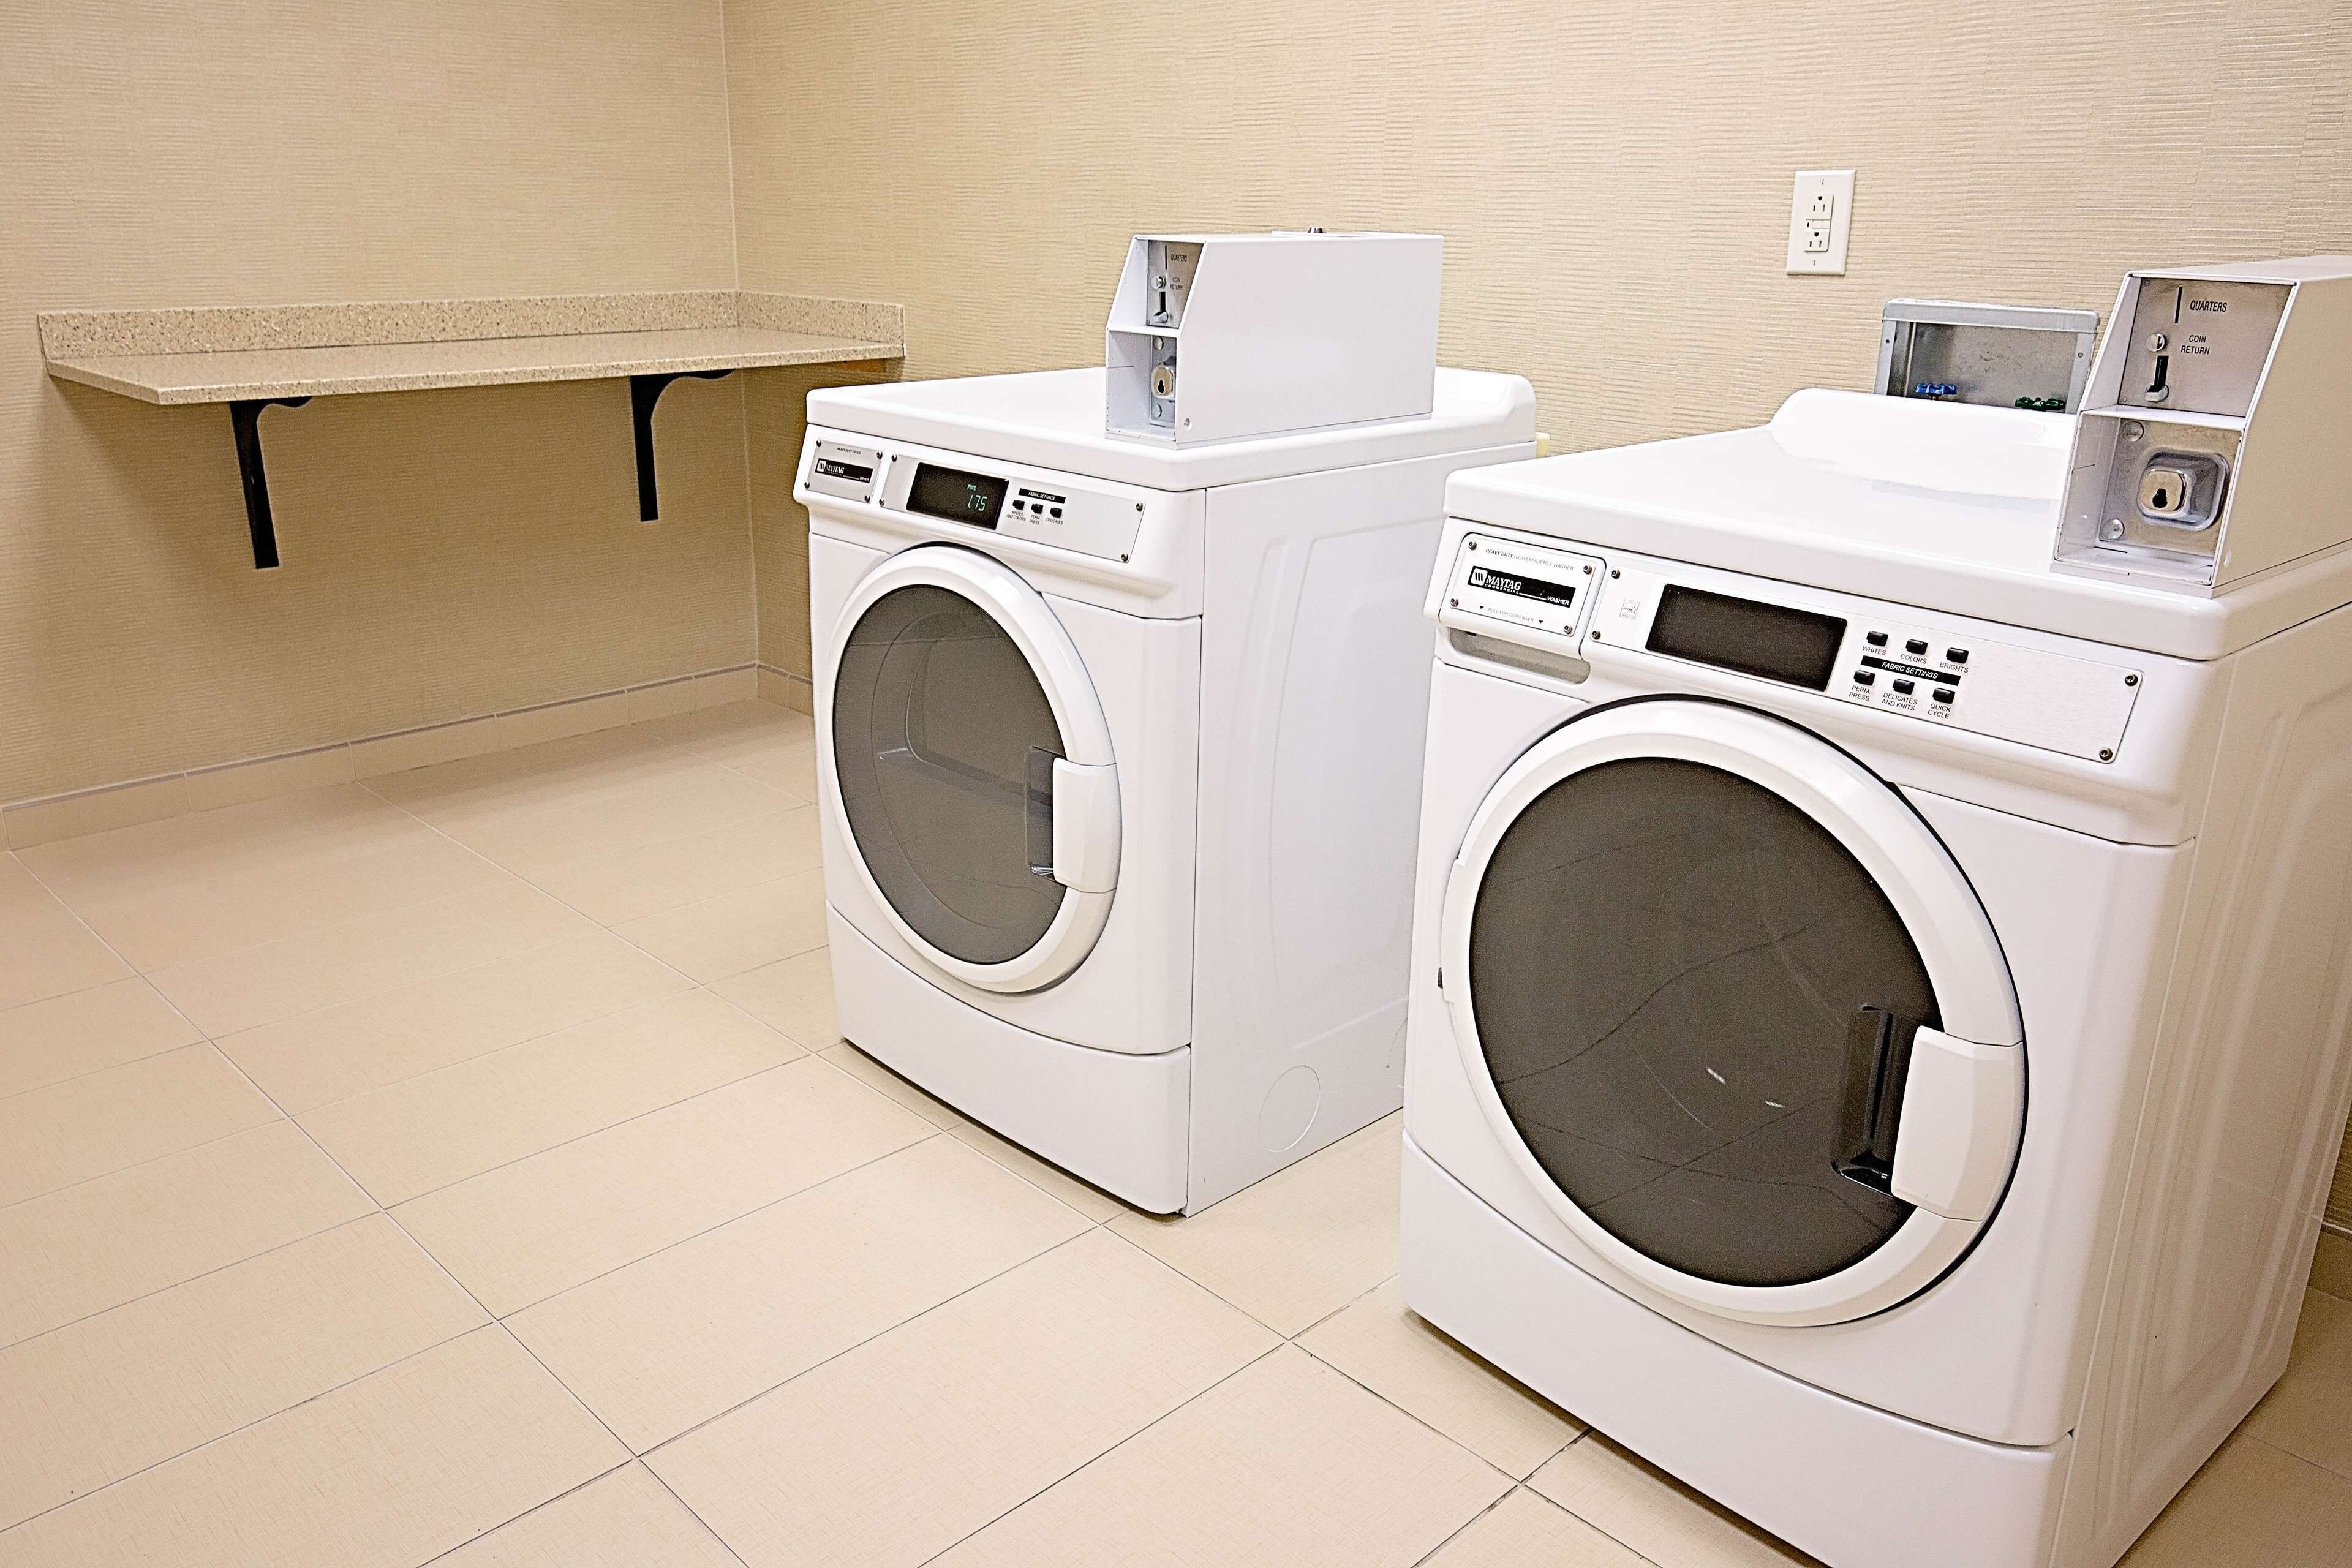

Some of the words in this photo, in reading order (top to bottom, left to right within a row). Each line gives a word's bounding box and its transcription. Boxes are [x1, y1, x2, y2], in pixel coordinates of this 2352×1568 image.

[2190, 300, 2228, 312] QUARTERS
[2189, 334, 2206, 343] COIN
[2181, 345, 2211, 355] RETURN
[824, 464, 845, 474] MAYTAG
[967, 494, 987, 511] 1.75
[1526, 557, 1553, 567] EFFICIENCY
[1485, 575, 1522, 590] MAYTAG
[1484, 584, 1519, 594] COMMERCIAL
[1547, 595, 1570, 605] WASHER
[1509, 612, 1534, 622] DISPENSER
[1863, 646, 1887, 655] WHITES
[1900, 654, 1928, 664] COLORS
[1881, 662, 1905, 672] FABRIC
[1905, 666, 1939, 679] SETTINGS
[1939, 662, 1969, 673] BRIGHTS
[1852, 685, 1871, 694] PERM.
[1849, 692, 1870, 701] PRESS
[1883, 692, 1918, 704] DELICATES
[1882, 699, 1896, 707] AND
[1896, 701, 1916, 711] KNITS
[1930, 704, 1951, 712] QUICK
[1928, 709, 1950, 719] CYCLE
